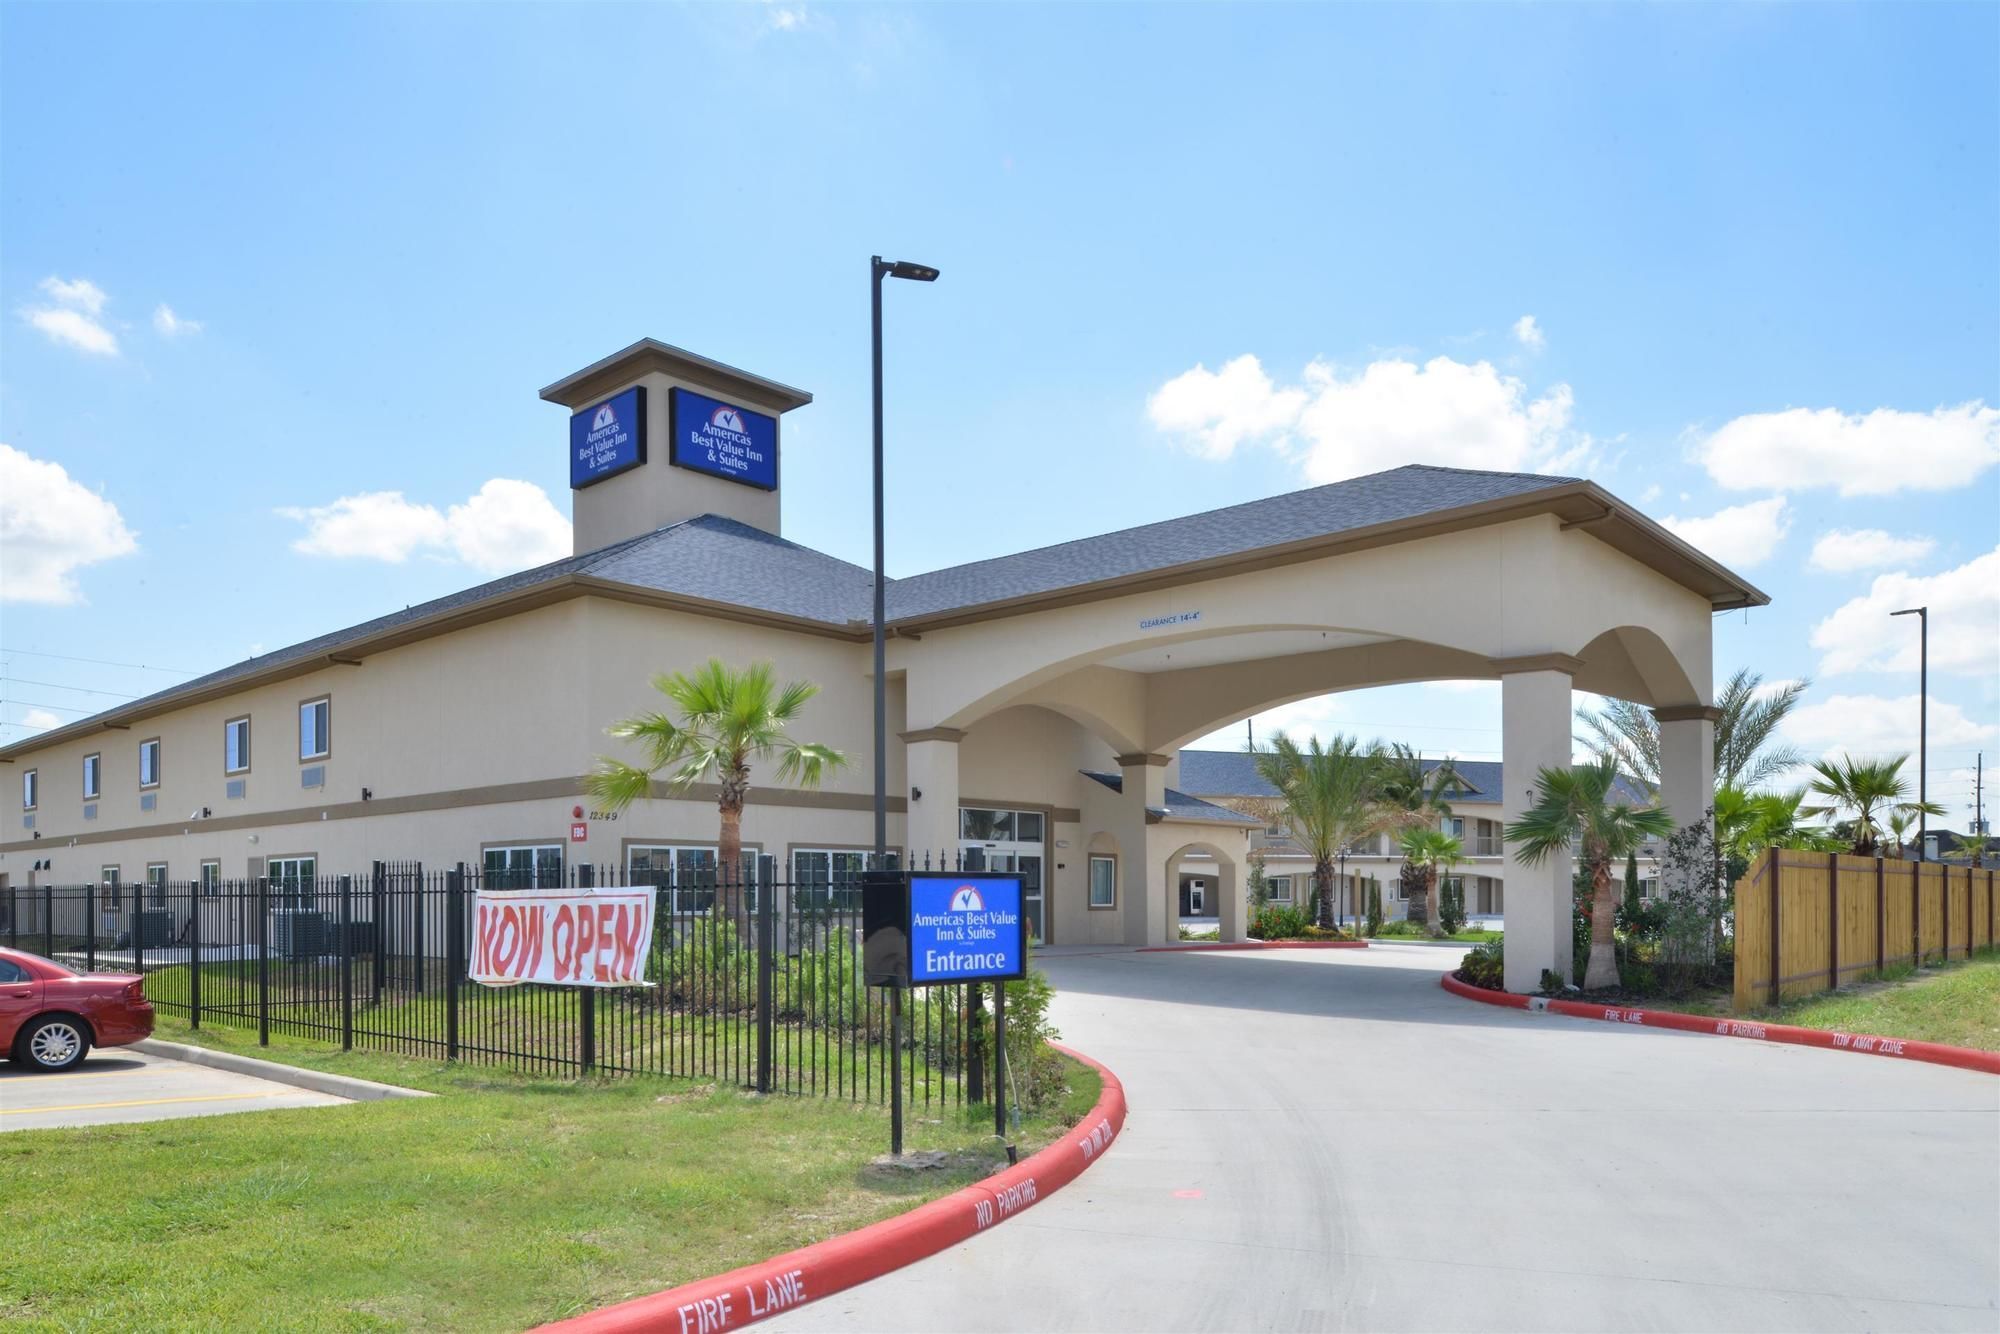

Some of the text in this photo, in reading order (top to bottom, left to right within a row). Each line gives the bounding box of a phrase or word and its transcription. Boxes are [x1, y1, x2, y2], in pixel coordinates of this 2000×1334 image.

[586, 423, 620, 444] Americas
[703, 421, 752, 446] Americas
[579, 432, 628, 460] Best Value Inn
[691, 431, 763, 463] Best Value Inn
[589, 457, 596, 469] &
[597, 450, 617, 466] Suites
[707, 449, 717, 462] &
[719, 452, 748, 471] Suites
[1140, 616, 1177, 629] CLEARANCE
[589, 811, 618, 821] 12349
[913, 910, 1017, 927] Americas Best Value
[477, 904, 642, 982] NOW OPEN
[936, 925, 996, 941] Inn & Suites
[926, 949, 1005, 973] Entrance
[1605, 1009, 1643, 1024] FIRE LANE
[1716, 1022, 1766, 1039] NO PARKING
[1832, 1033, 1907, 1055] TOW AWAY ZONE
[974, 1178, 1037, 1229] NO PARKING
[745, 1270, 807, 1317] LANE
